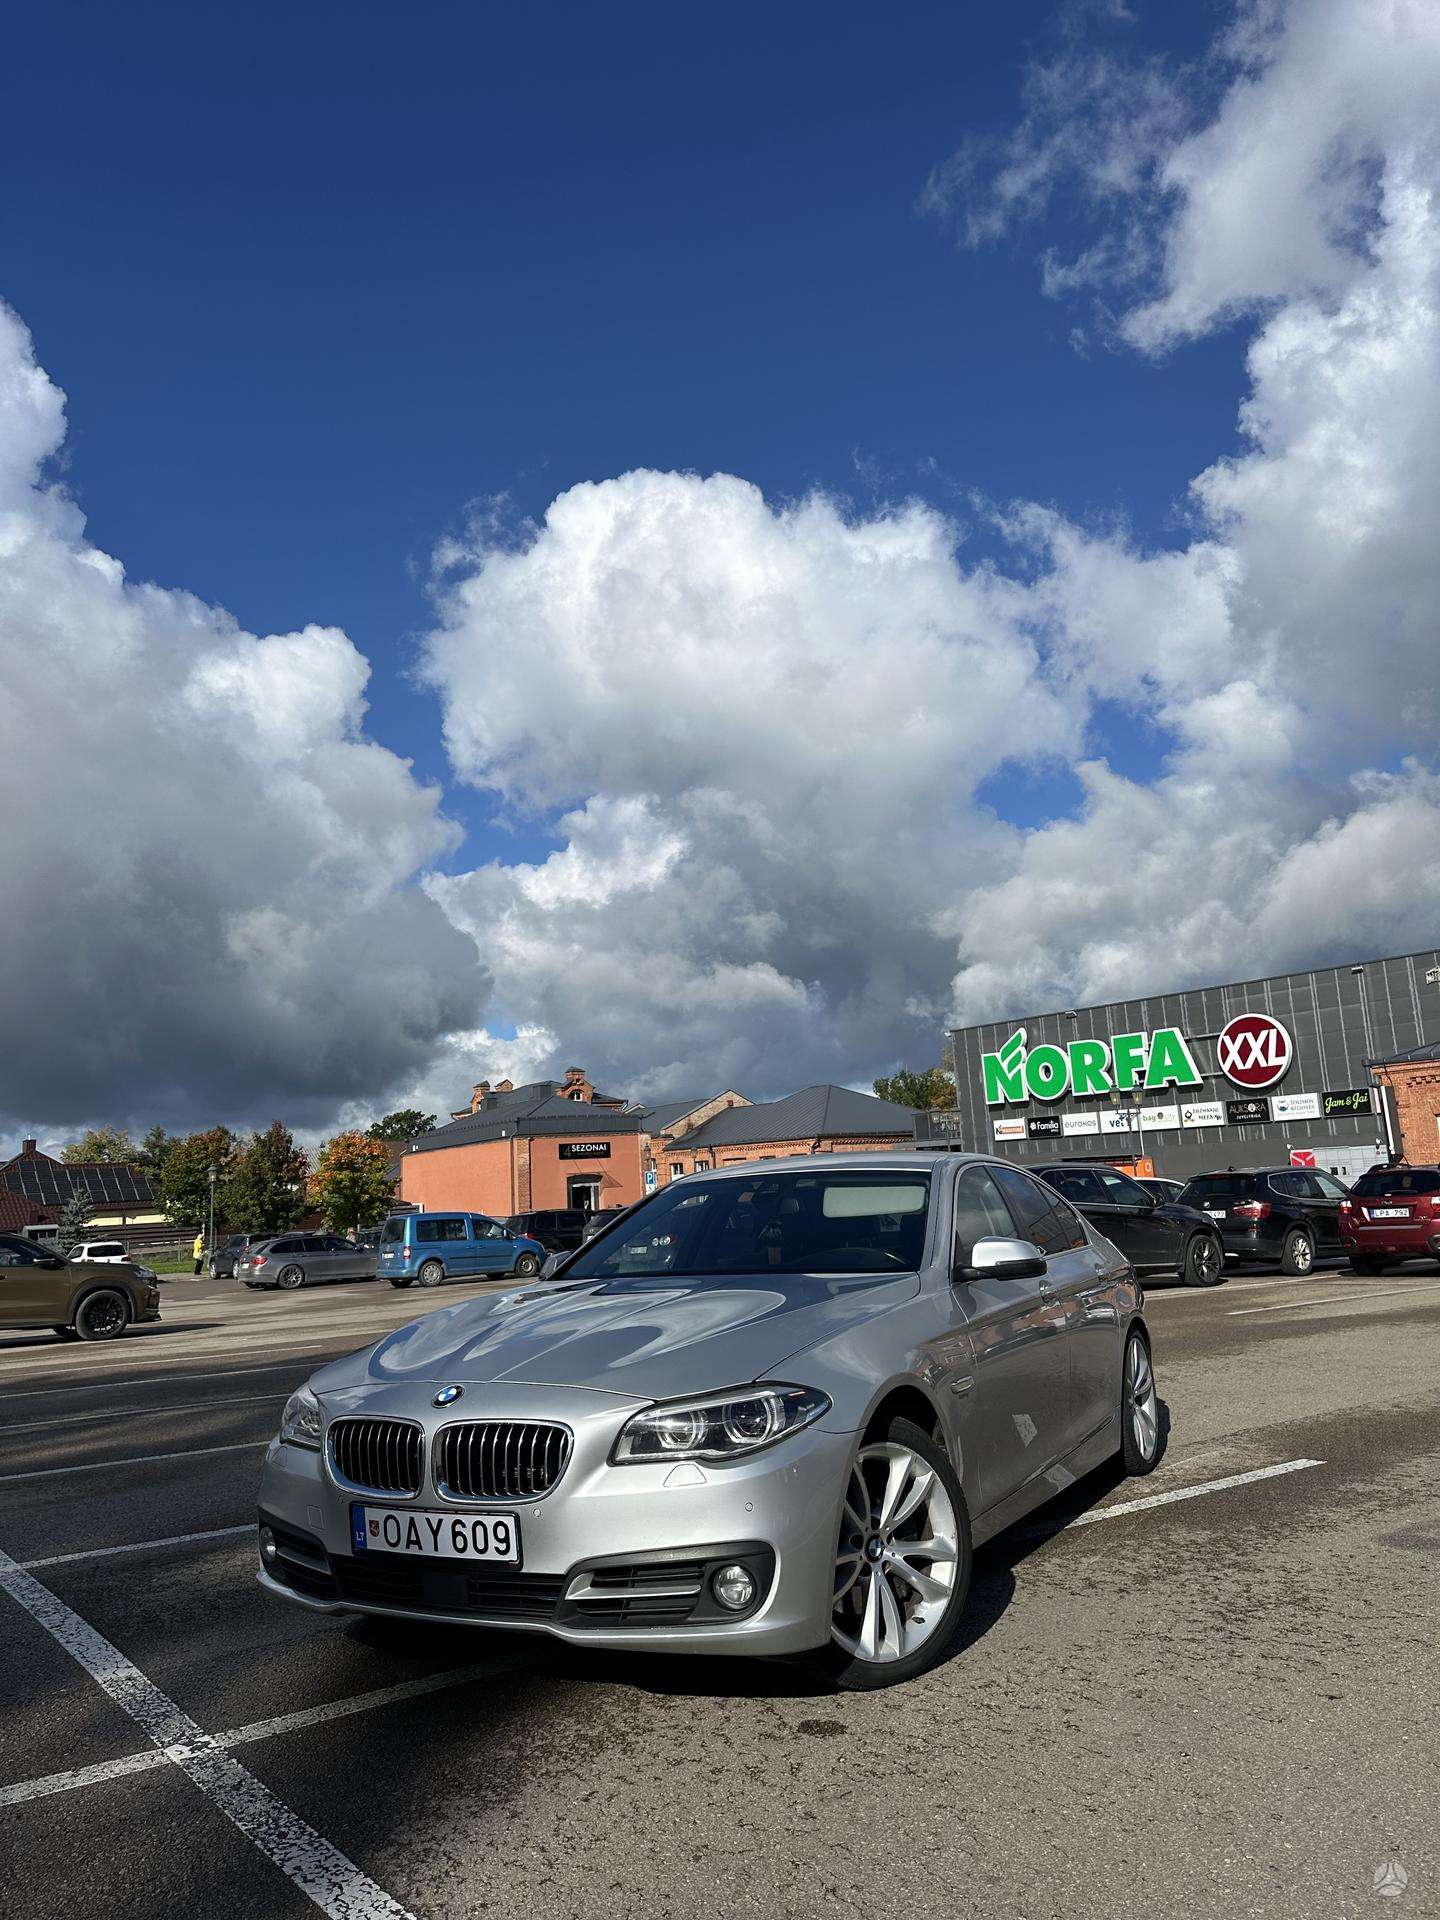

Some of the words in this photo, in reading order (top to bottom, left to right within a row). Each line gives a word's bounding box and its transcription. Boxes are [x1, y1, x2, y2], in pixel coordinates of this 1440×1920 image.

[1221, 1028, 1287, 1070] XXL
[982, 1027, 1204, 1104] NORFA
[1325, 1097, 1345, 1113] Jam
[1345, 1096, 1352, 1105] &
[1352, 1092, 1368, 1109] Jai
[1037, 1120, 1058, 1130] Familia
[1142, 1114, 1156, 1122] bag
[571, 1144, 607, 1152] SEZONAI
[646, 1173, 653, 1184] P
[355, 1531, 365, 1541] LT
[383, 1514, 443, 1552] OAY
[451, 1518, 511, 1556] 609
